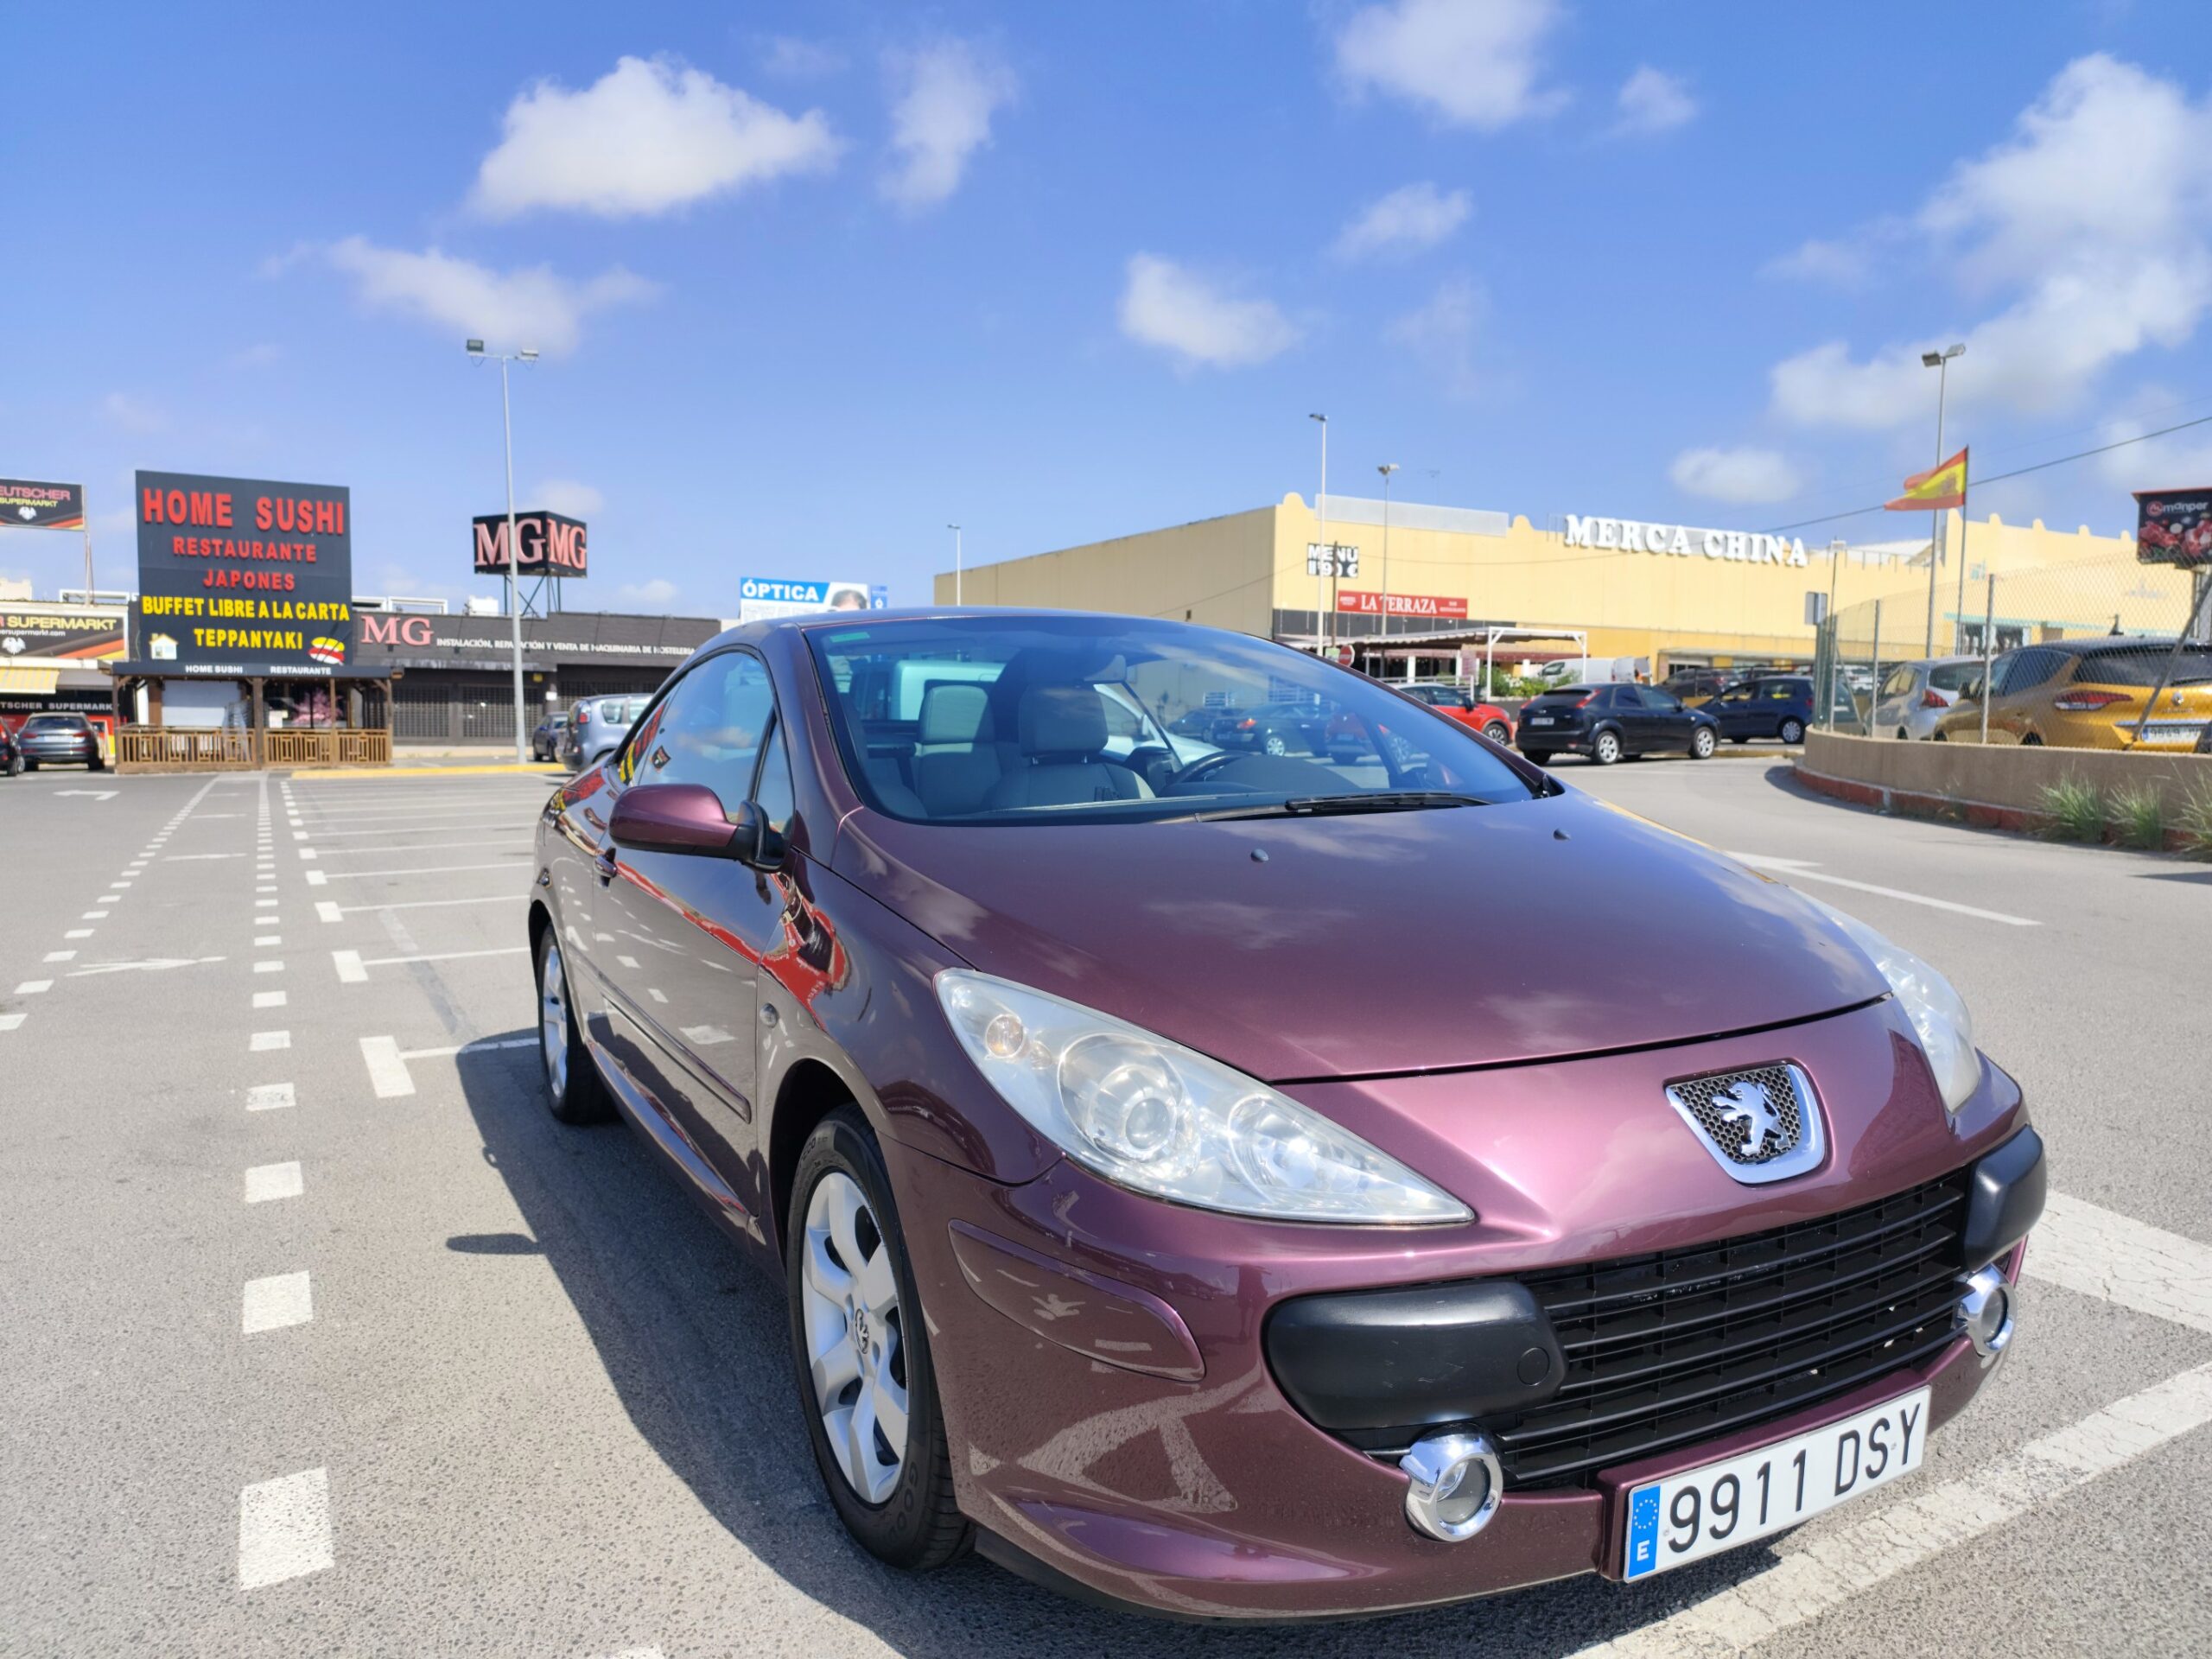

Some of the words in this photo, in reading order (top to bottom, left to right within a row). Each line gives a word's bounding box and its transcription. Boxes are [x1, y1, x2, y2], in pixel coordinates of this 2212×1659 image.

[0, 497, 58, 507] SUPERMARKT
[143, 487, 232, 527] HOME
[256, 497, 344, 534] SUSHI
[173, 536, 316, 562] RESTAURANTE
[474, 518, 546, 565] MG
[547, 518, 587, 569] MG
[1565, 514, 1692, 556] MERCA
[1703, 529, 1808, 567] CHINA
[202, 569, 295, 591] JAPONES
[742, 579, 819, 601] ÓPTICA
[143, 596, 204, 616] BUFFET
[209, 598, 255, 619] LIBRE
[258, 601, 270, 619] A
[272, 601, 293, 620] LA
[296, 602, 350, 621] CARTA
[1361, 594, 1377, 610] LA
[0, 628, 66, 638] ersupermarkt.com
[7, 615, 117, 630] SUPERMARKT
[360, 615, 435, 646] MG
[194, 628, 302, 650] TEPPANYAKI
[494, 639, 544, 651] REPAACIÓN
[553, 642, 578, 652] VENTA
[186, 664, 213, 674] HOME
[214, 665, 243, 674] SUSHI
[270, 666, 332, 676] RESTAURANTE
[1668, 1449, 1806, 1554] 9911
[1834, 1402, 1920, 1497] DSY
[1637, 1540, 1650, 1562] E
